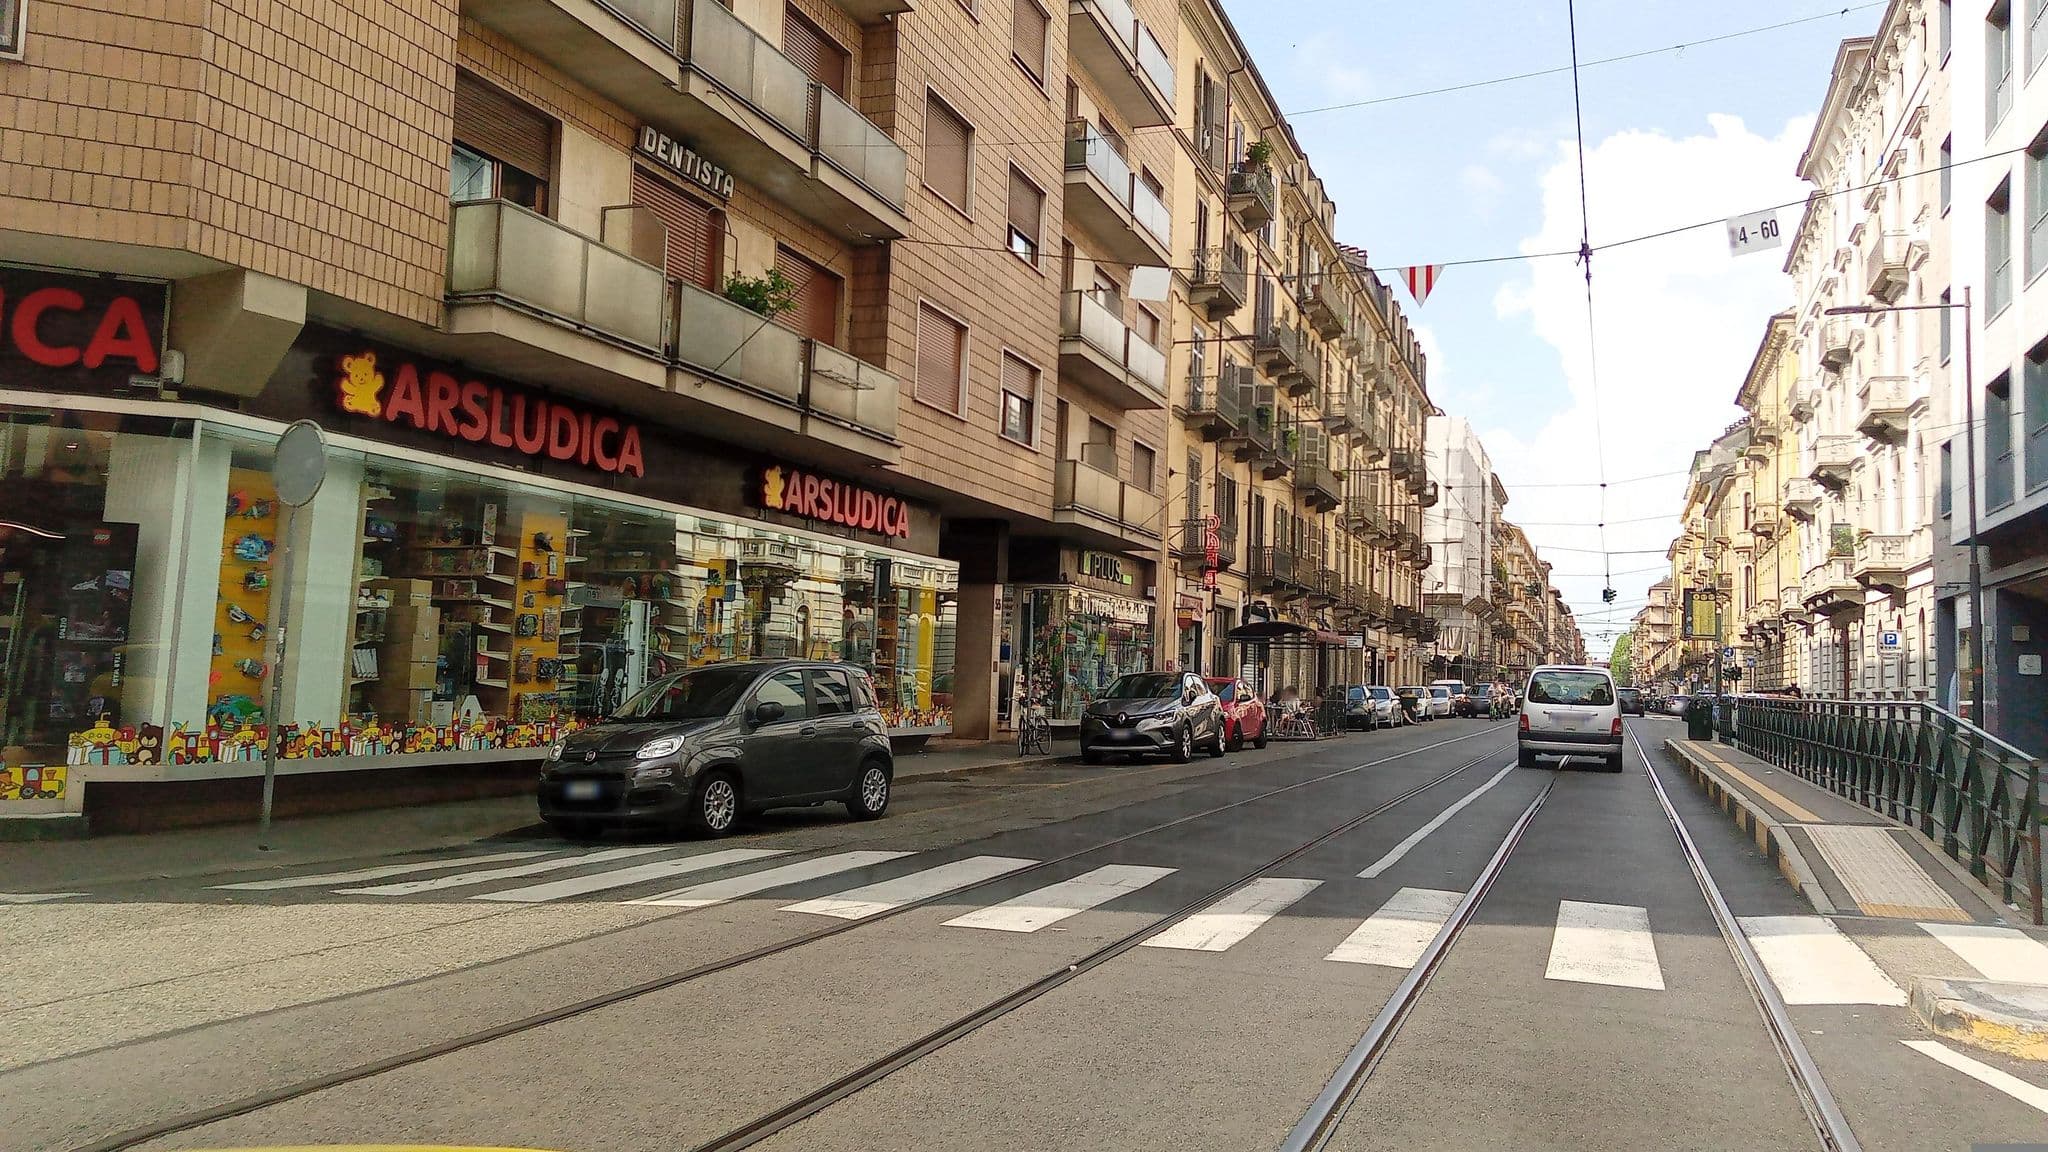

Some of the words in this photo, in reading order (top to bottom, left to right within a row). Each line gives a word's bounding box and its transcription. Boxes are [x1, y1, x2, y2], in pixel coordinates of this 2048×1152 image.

[642, 126, 735, 197] DENTISTA
[0, 286, 158, 374] CA
[385, 362, 645, 478] ARSLUDICA
[784, 469, 911, 539] ARSLUDICA
